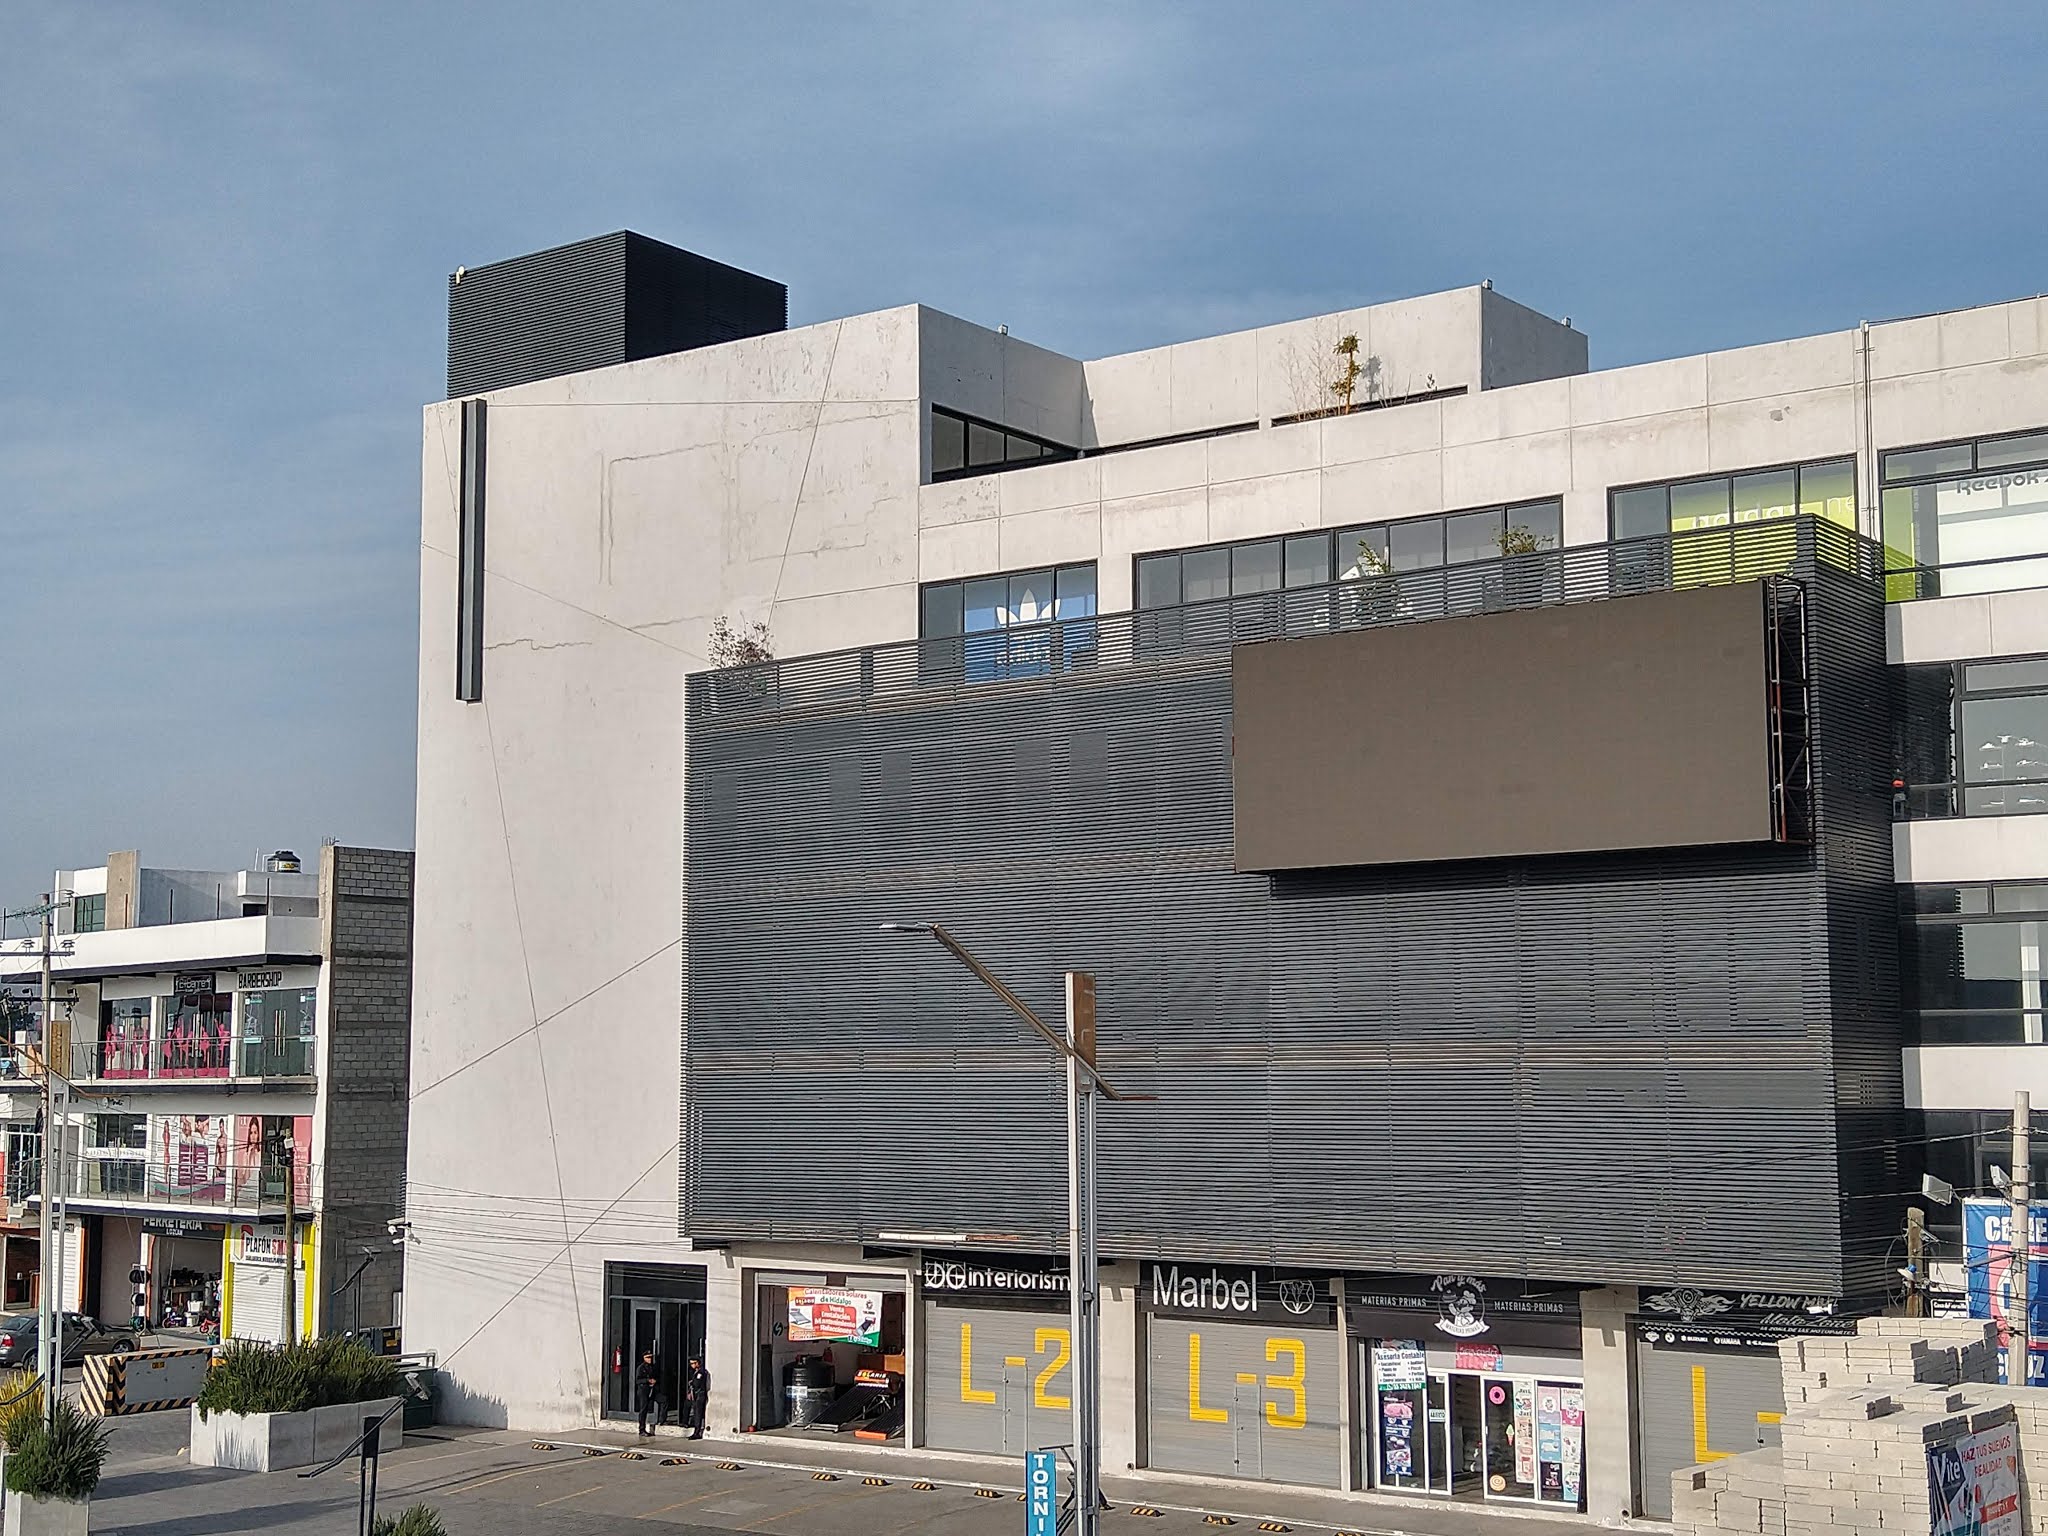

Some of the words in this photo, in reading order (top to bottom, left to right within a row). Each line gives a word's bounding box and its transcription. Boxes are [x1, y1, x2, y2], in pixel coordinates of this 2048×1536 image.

[1957, 472, 2039, 495] Reebok
[238, 971, 282, 989] BARBERSHOP
[968, 1267, 1084, 1291] interiorism
[804, 1287, 845, 1298] Calentadores
[846, 1290, 868, 1300] Solares
[1153, 1265, 1258, 1312] Marbel
[829, 1304, 845, 1313] Venta
[830, 1296, 852, 1305] Hidalgo
[1361, 1295, 1397, 1307] MATERIAS
[1399, 1297, 1427, 1308] PRIMAS
[1494, 1301, 1532, 1312] MATERIAS
[1533, 1303, 1564, 1314] PRIMAS
[1740, 1293, 1802, 1309] YELLOW
[857, 1370, 887, 1379] SOLARIS
[961, 1322, 1071, 1409] L-2
[1189, 1333, 1308, 1429] L-3
[1961, 1447, 1975, 1463] HAZ
[1976, 1443, 1987, 1458] TUS
[1032, 1453, 1049, 1536] TORNI
